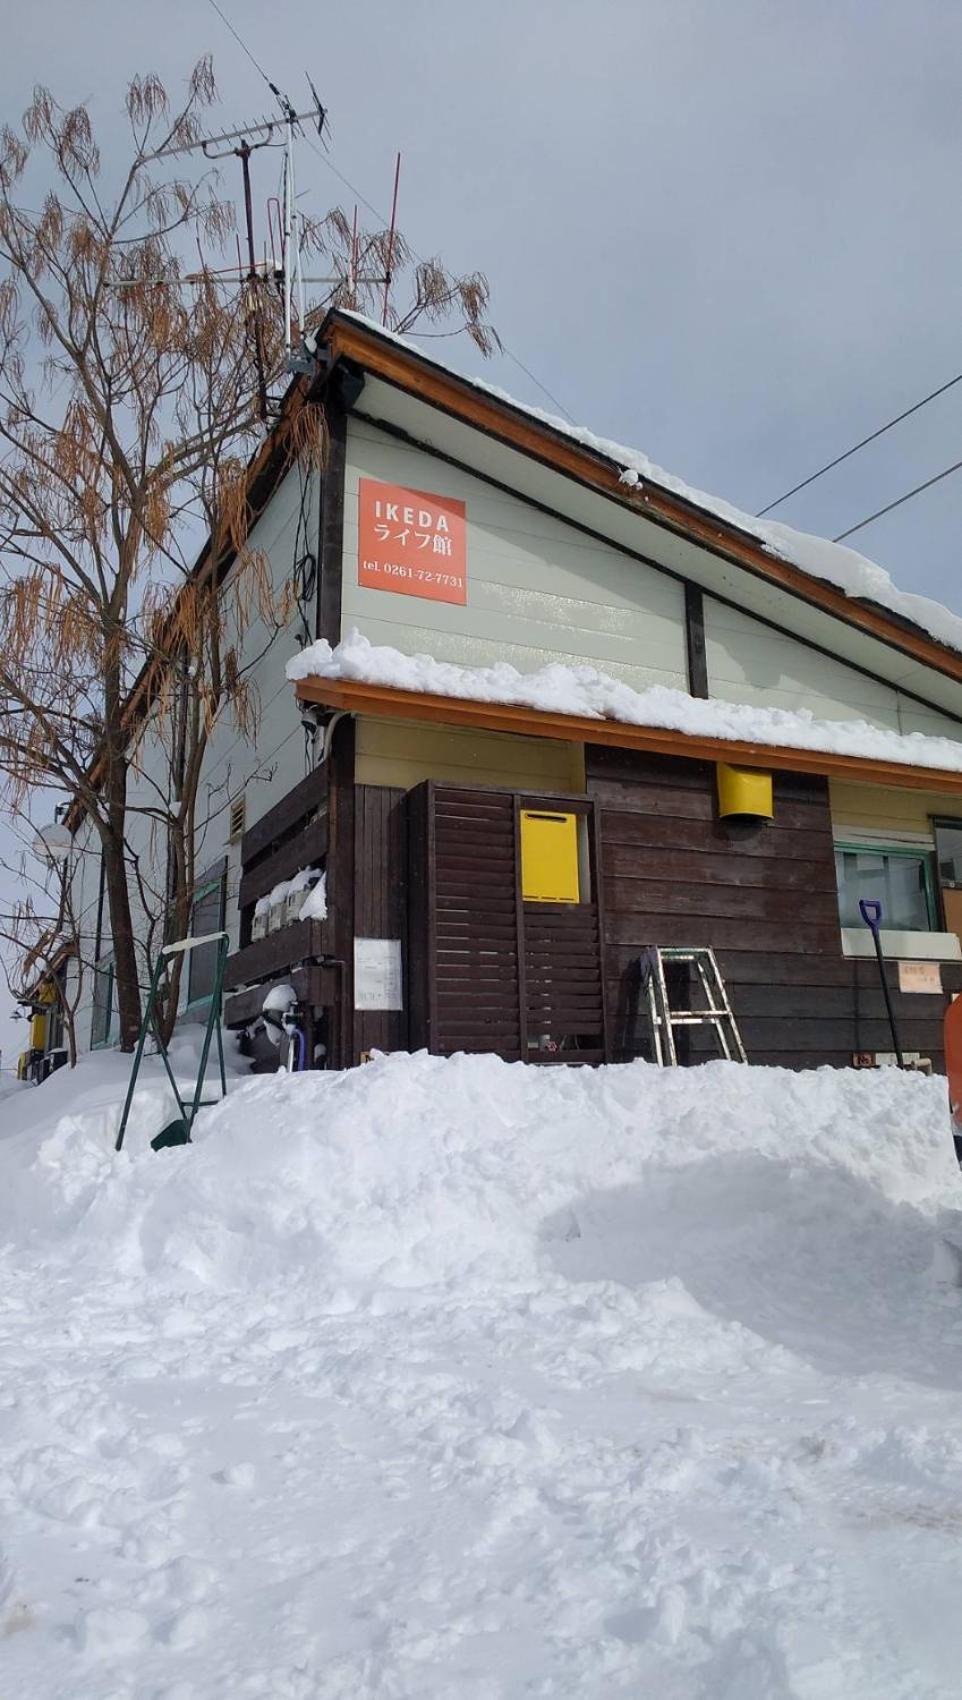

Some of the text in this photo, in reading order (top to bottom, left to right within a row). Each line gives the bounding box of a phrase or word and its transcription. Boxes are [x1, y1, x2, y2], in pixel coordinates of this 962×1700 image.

[375, 500, 449, 532] IKEDA
[374, 523, 453, 556] ライフ館
[384, 564, 463, 588] 0261-72-7731
